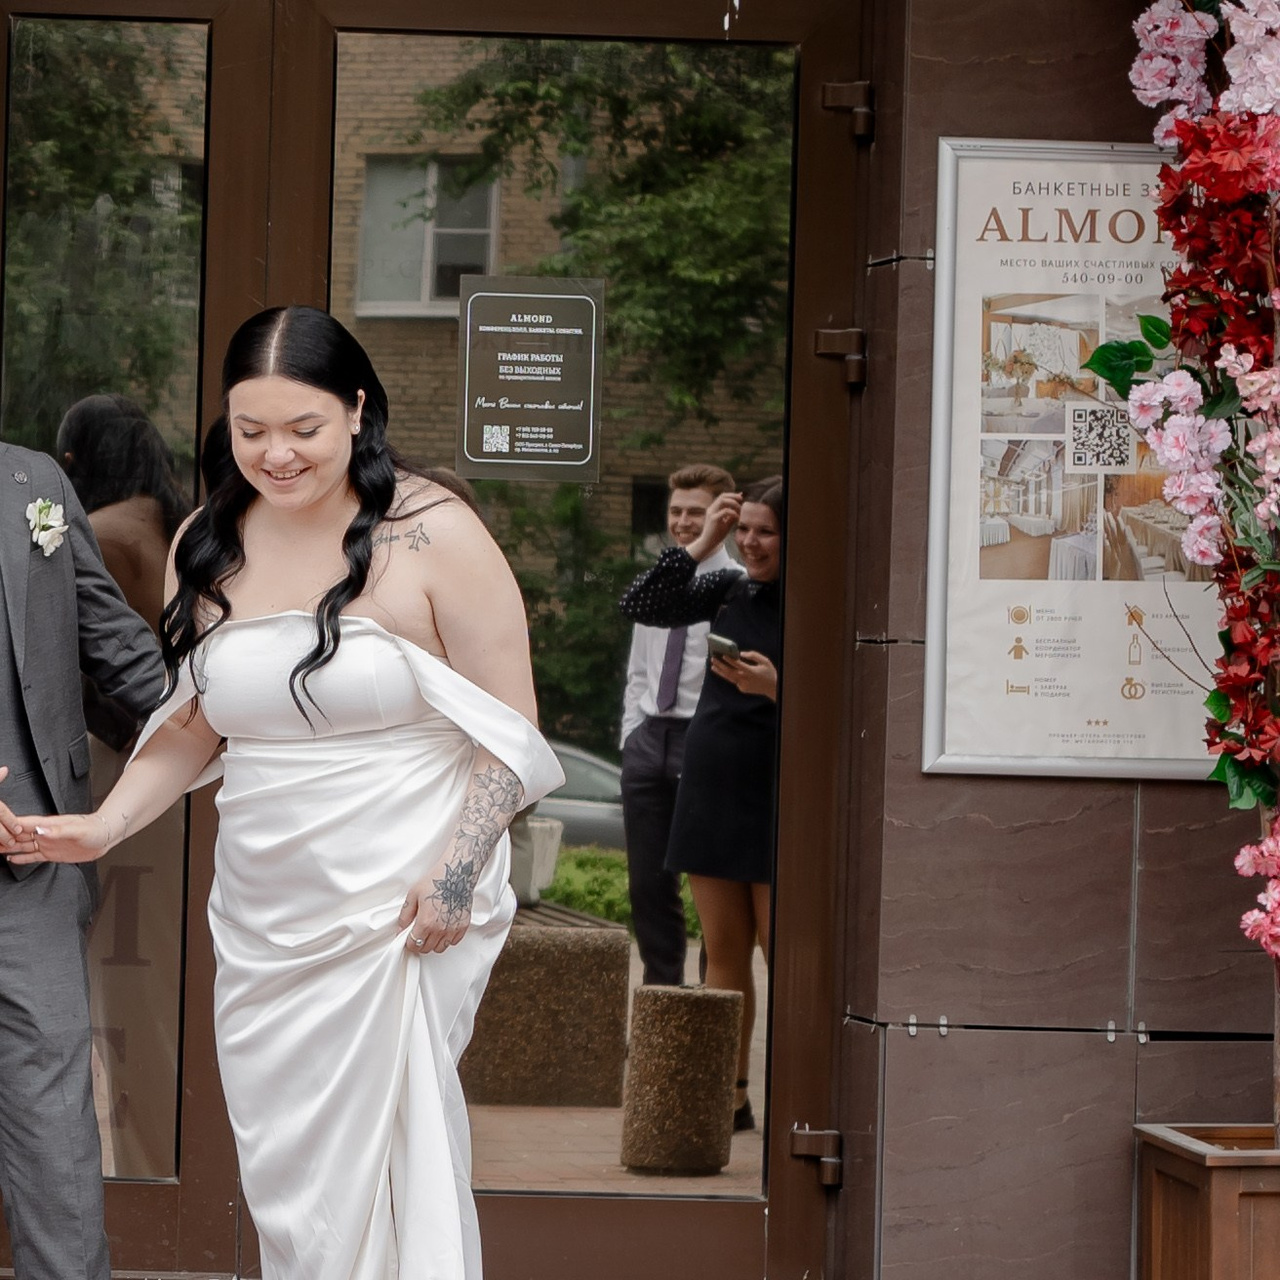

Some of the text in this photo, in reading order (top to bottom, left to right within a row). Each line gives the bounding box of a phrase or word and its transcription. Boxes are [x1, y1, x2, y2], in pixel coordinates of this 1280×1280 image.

[1012, 181, 1131, 197] БАНКЕТНЫЕ
[1000, 258, 1037, 268] МЕСТО
[1041, 259, 1079, 269] ВАШИХ
[1084, 260, 1155, 270] СЧАСТЛИВЫХ
[1061, 272, 1144, 285] 540-09-00
[510, 314, 553, 323] ALMOND
[497, 352, 563, 362] ГРАФИК РАБОТЫ
[499, 365, 561, 375] БЕЗ ВЫХОДНЫХ
